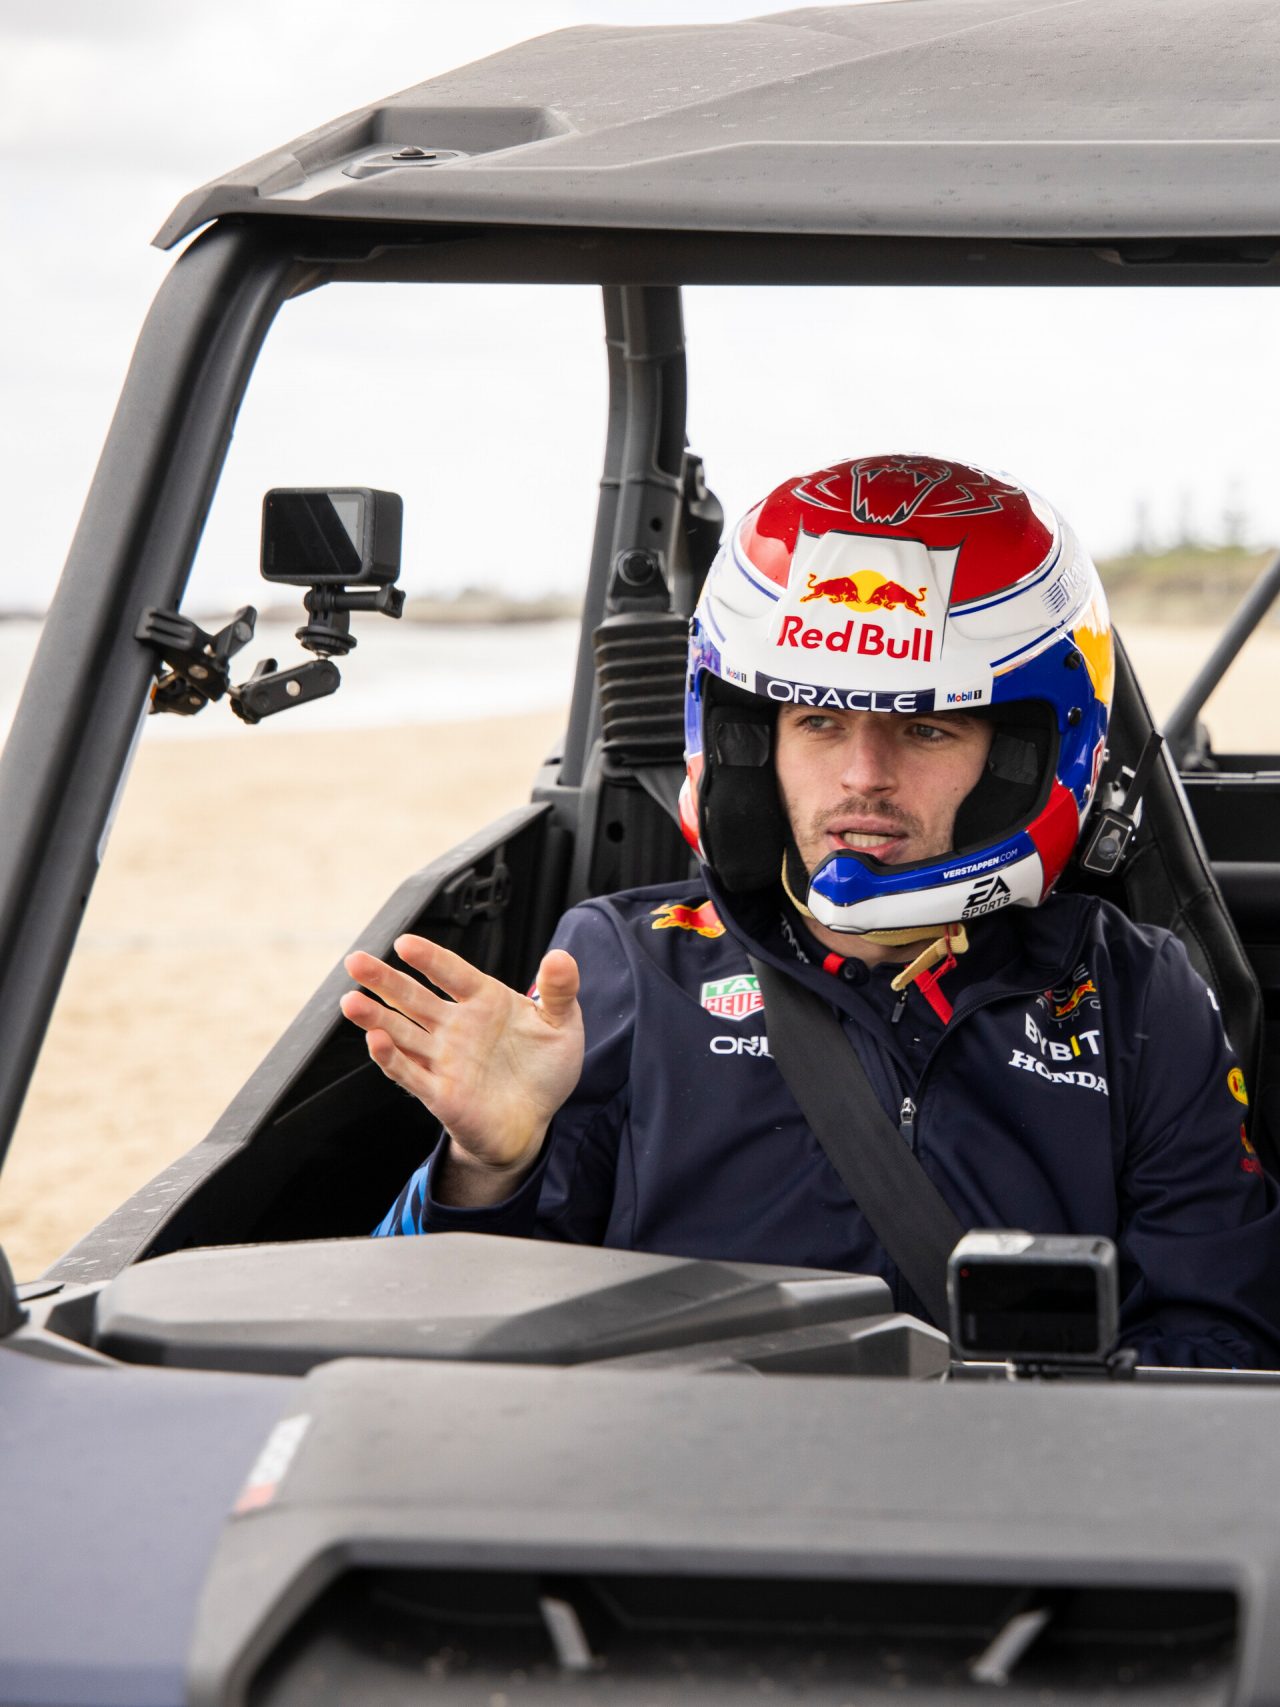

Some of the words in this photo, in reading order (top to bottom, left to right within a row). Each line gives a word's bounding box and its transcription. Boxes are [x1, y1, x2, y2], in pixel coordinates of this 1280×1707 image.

[776, 615, 854, 653] Red
[857, 623, 933, 663] Bull
[767, 680, 918, 713] ORACLE
[947, 691, 972, 703] Mobil
[943, 848, 1018, 880] VERSTAPPEN.COM
[961, 894, 1011, 920] SPORTS
[964, 875, 1011, 909] EA
[706, 992, 763, 1016] HEUE
[1025, 1012, 1101, 1061] BYBIT
